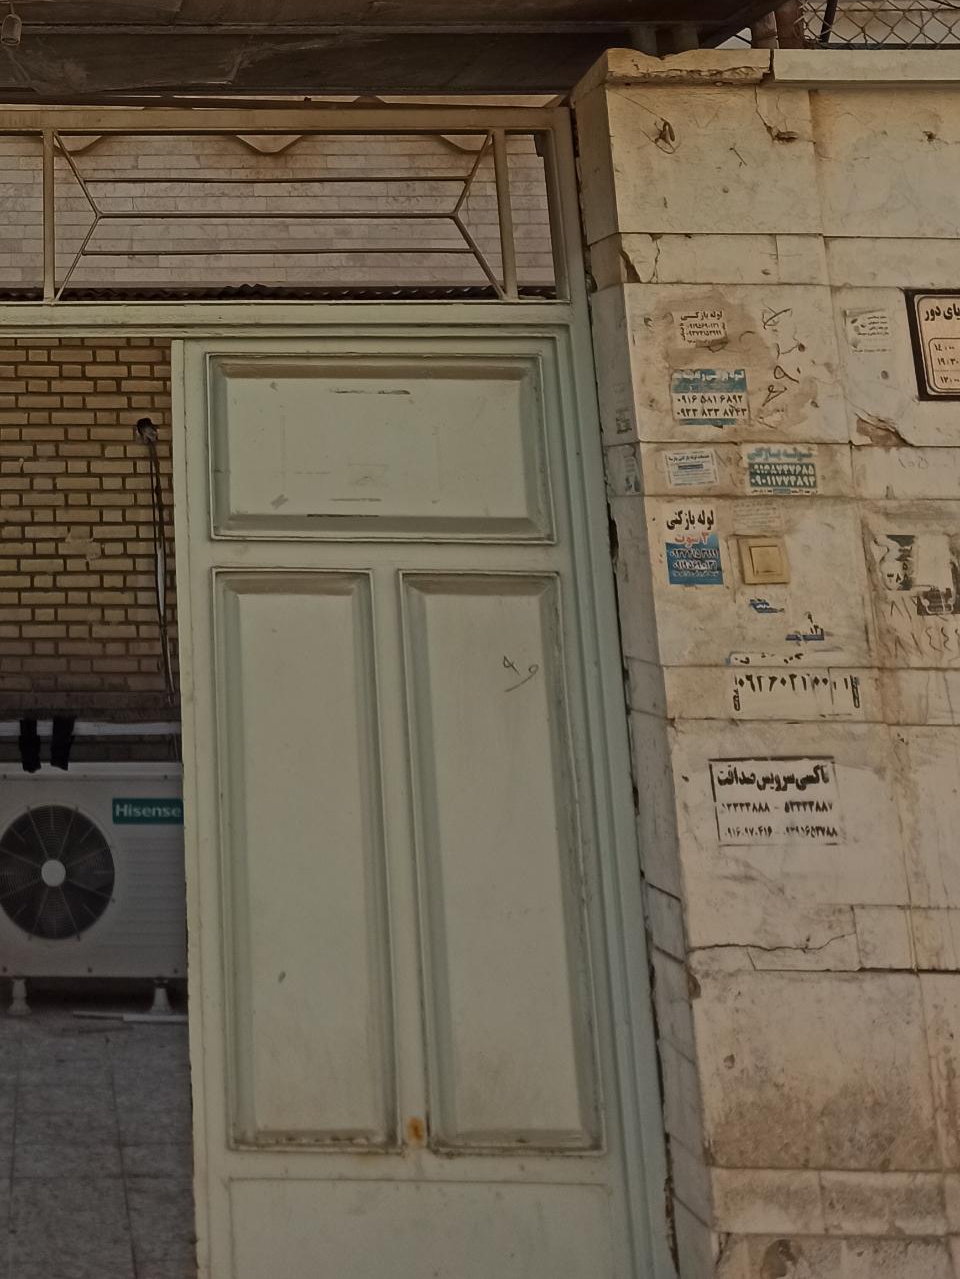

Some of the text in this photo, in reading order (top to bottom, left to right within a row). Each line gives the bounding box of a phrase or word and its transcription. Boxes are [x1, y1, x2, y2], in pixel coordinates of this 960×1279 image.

[924, 305, 942, 322] دور
[699, 509, 714, 530] لوله
[757, 772, 795, 791] سرویس
[115, 804, 181, 818] Hisense
